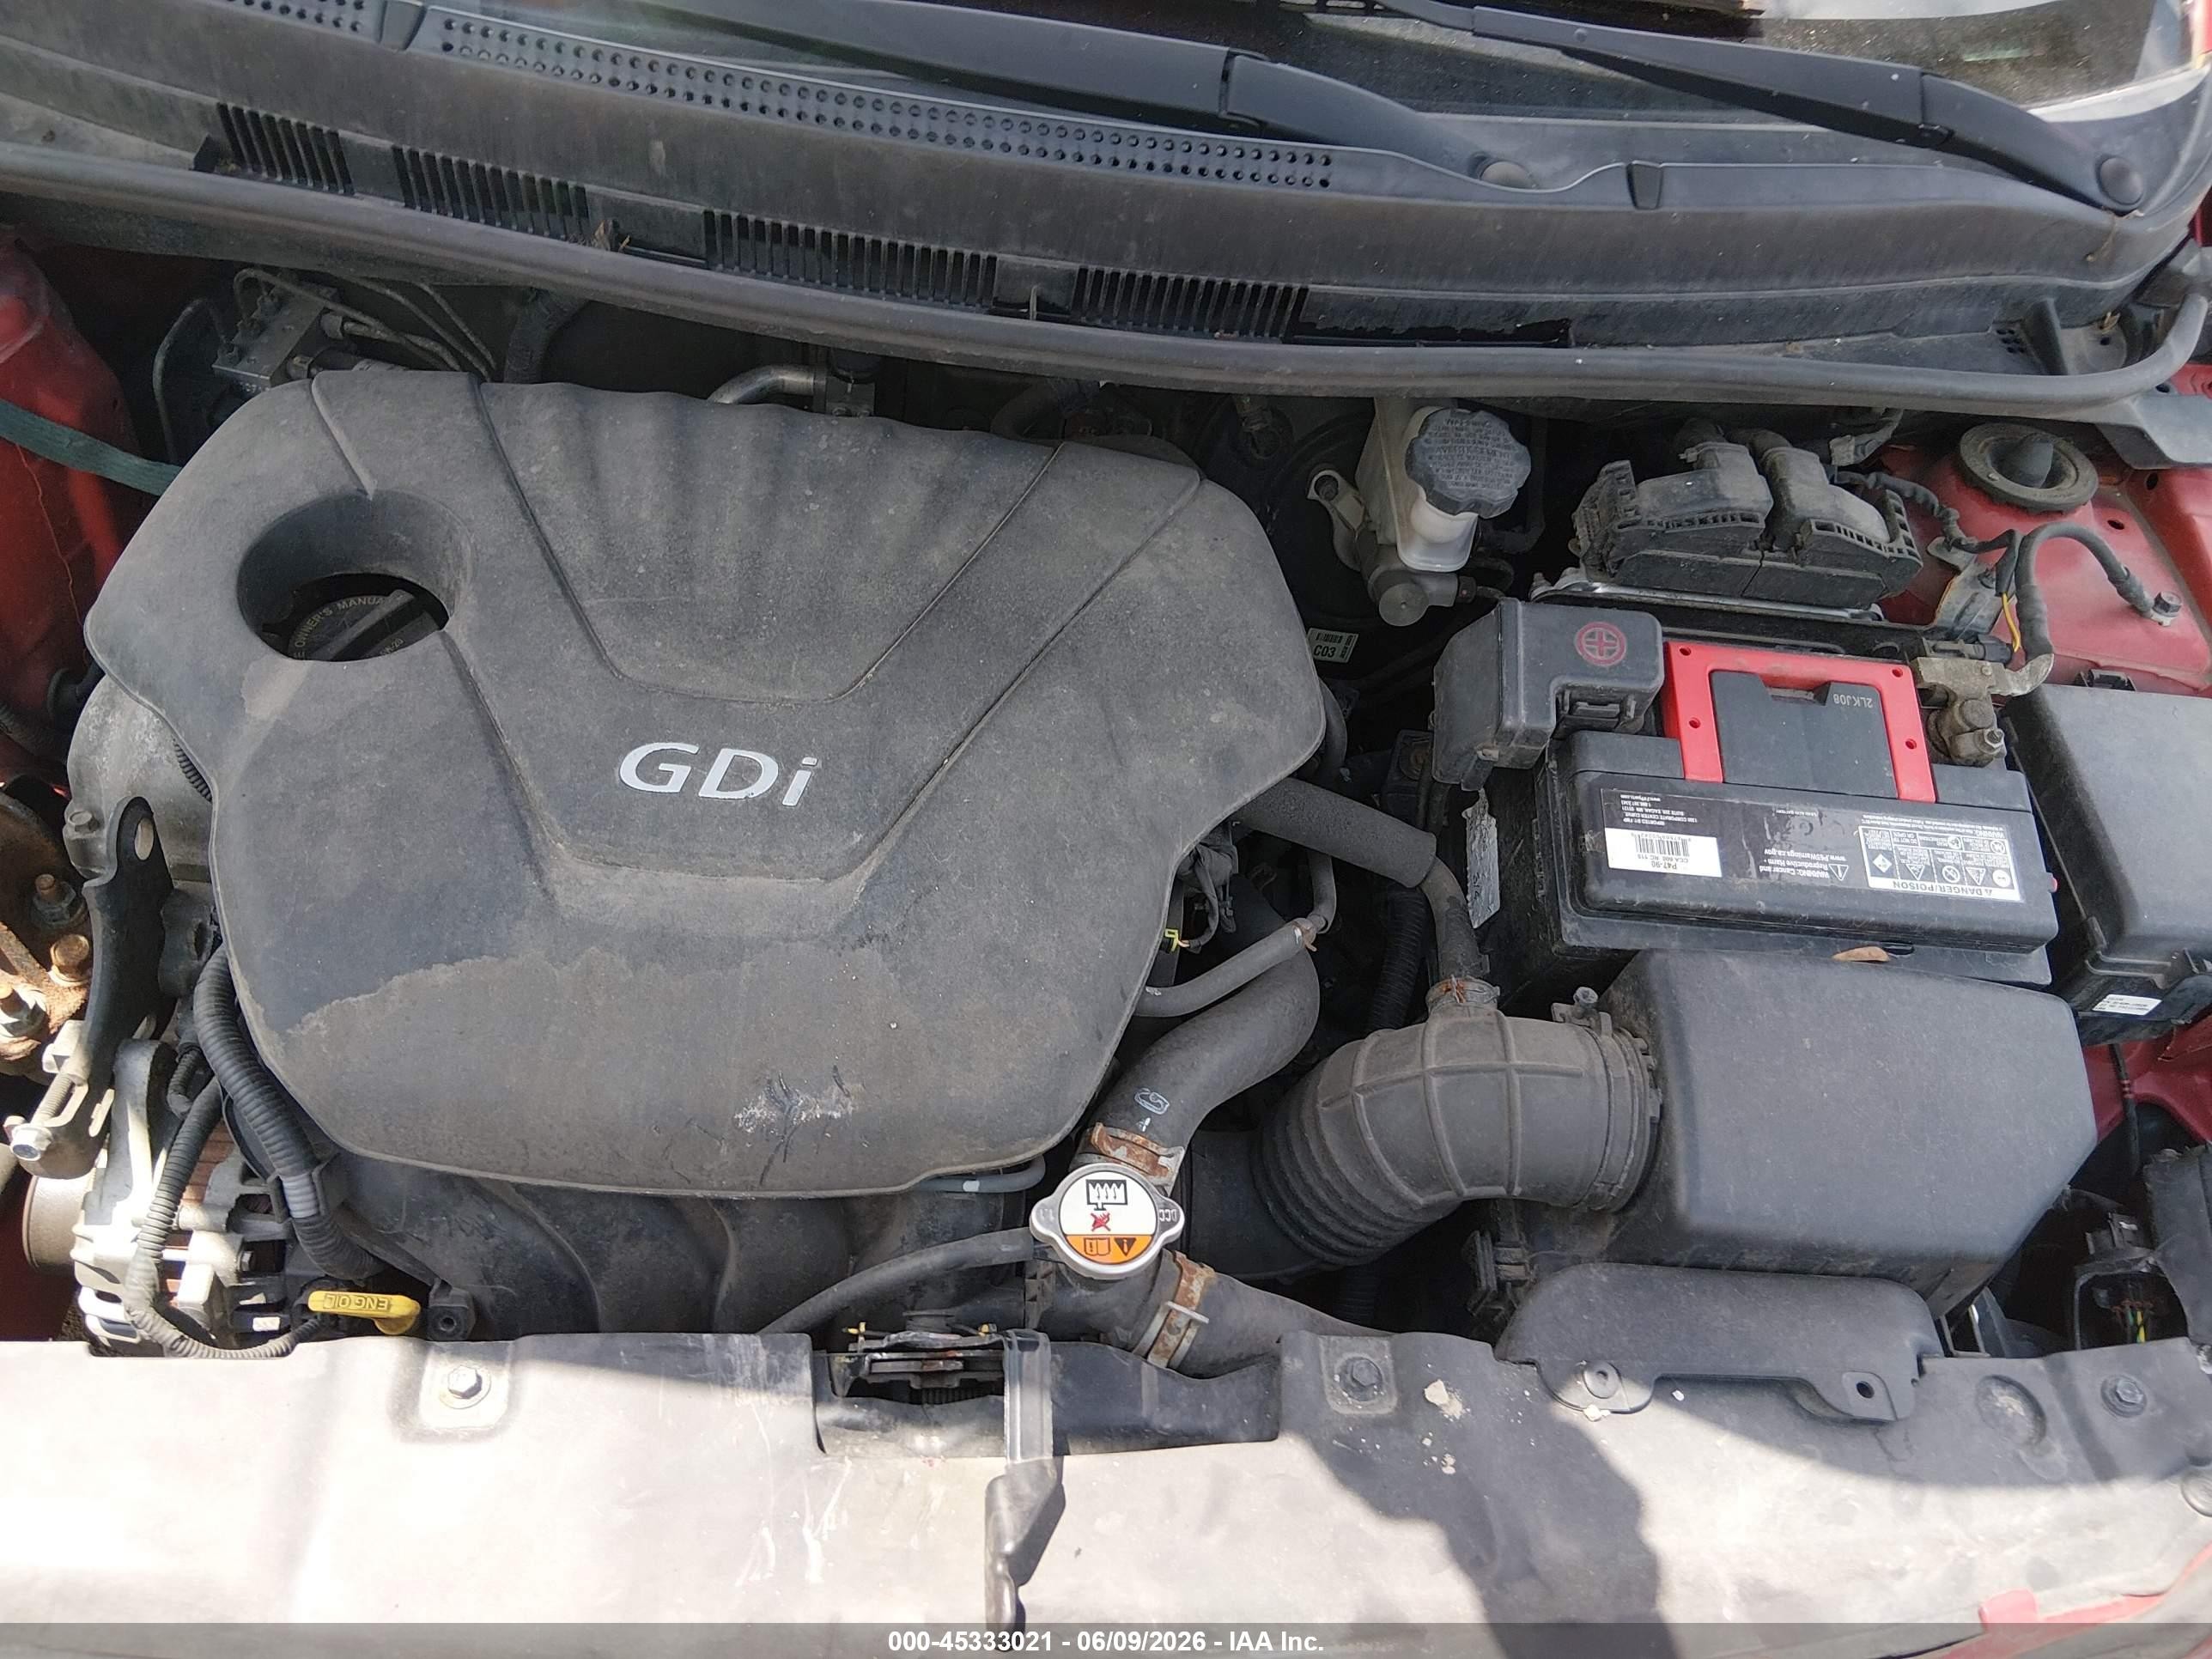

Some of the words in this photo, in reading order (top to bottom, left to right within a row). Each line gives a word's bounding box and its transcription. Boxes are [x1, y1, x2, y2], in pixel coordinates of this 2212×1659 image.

[295, 607, 333, 647] OWNER'S
[337, 597, 386, 611] MANUA
[1314, 644, 1337, 658] C03
[1832, 693, 1873, 708] 2LKJ08
[619, 742, 818, 807] GDi
[1786, 860, 1828, 871] Reproductive
[1796, 869, 1830, 878] WARNING:
[1893, 881, 1982, 896] DANGER/POISON
[1159, 1208, 1177, 1223] DCC
[324, 1293, 350, 1310] OIL
[355, 1296, 391, 1311] ENG
